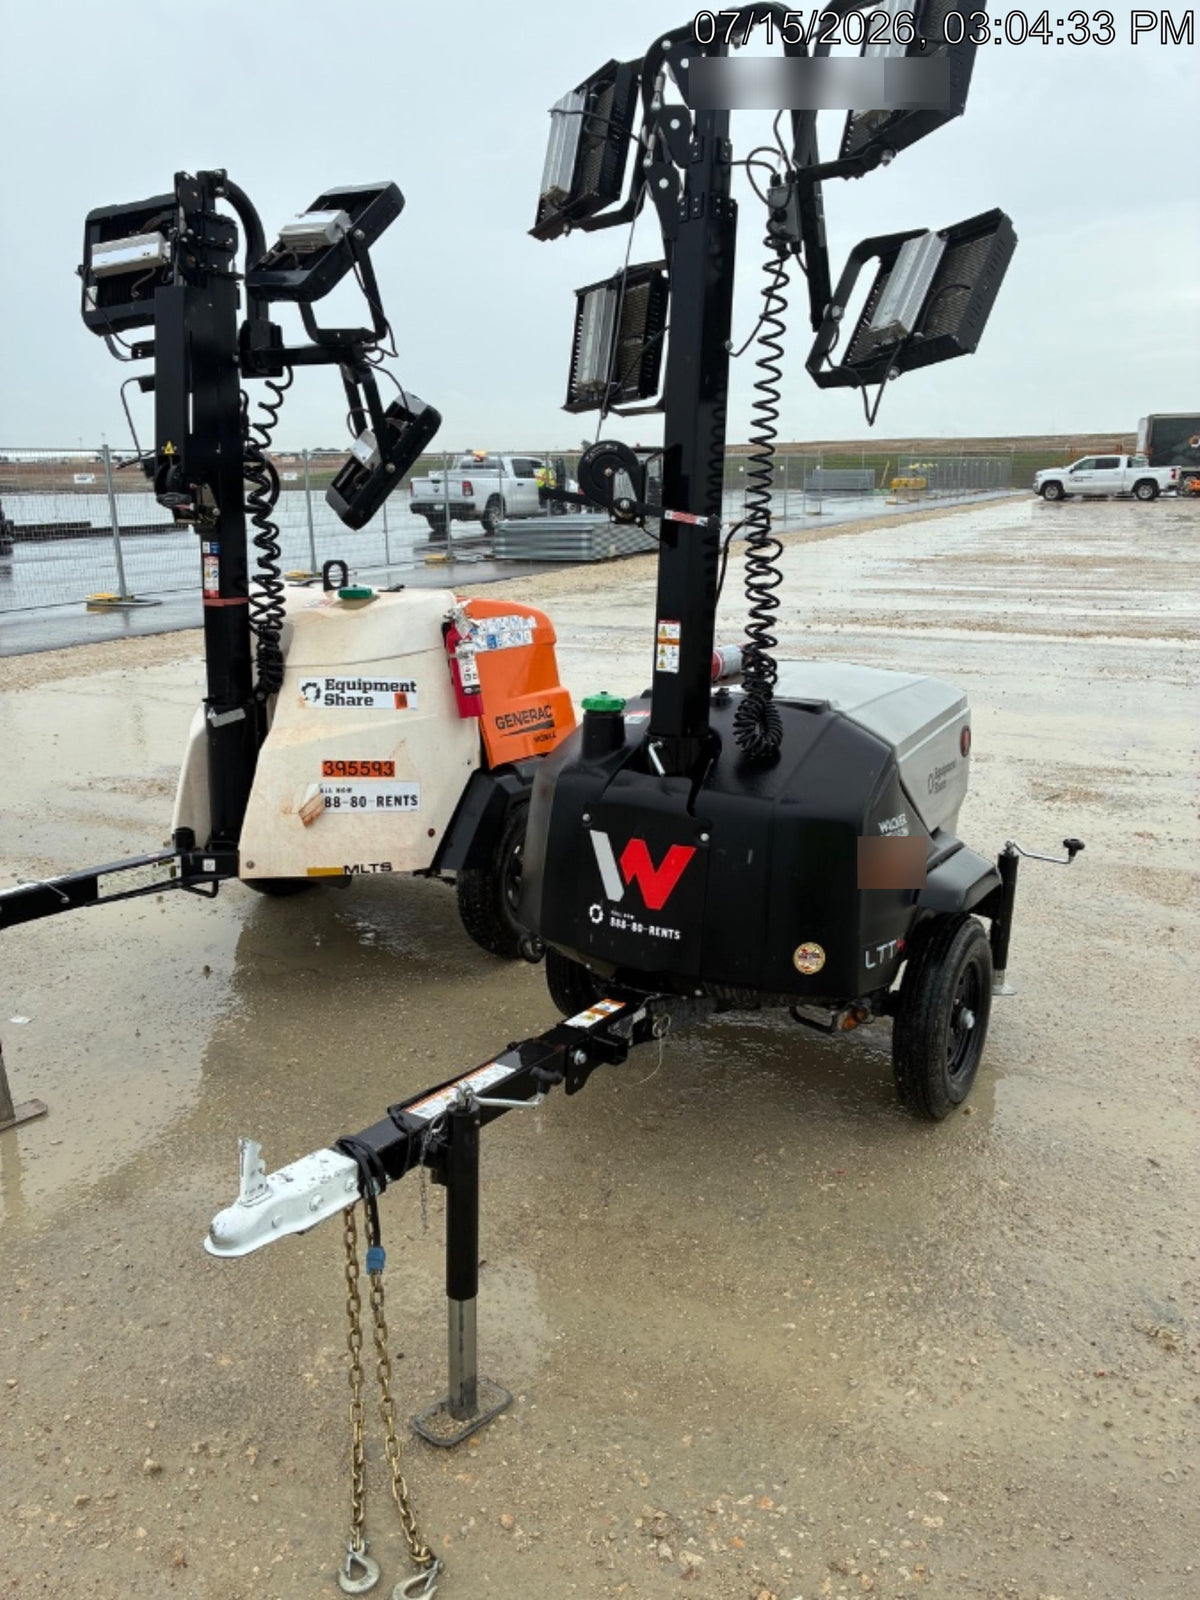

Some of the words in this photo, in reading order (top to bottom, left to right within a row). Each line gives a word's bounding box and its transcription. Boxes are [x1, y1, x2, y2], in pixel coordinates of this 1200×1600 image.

[324, 678, 417, 694] Equipment
[323, 692, 375, 707] Share
[495, 705, 552, 730] GENERAC
[322, 761, 395, 776] 395593
[324, 794, 419, 808] 88-80-RENTS
[343, 861, 393, 875] MLTS
